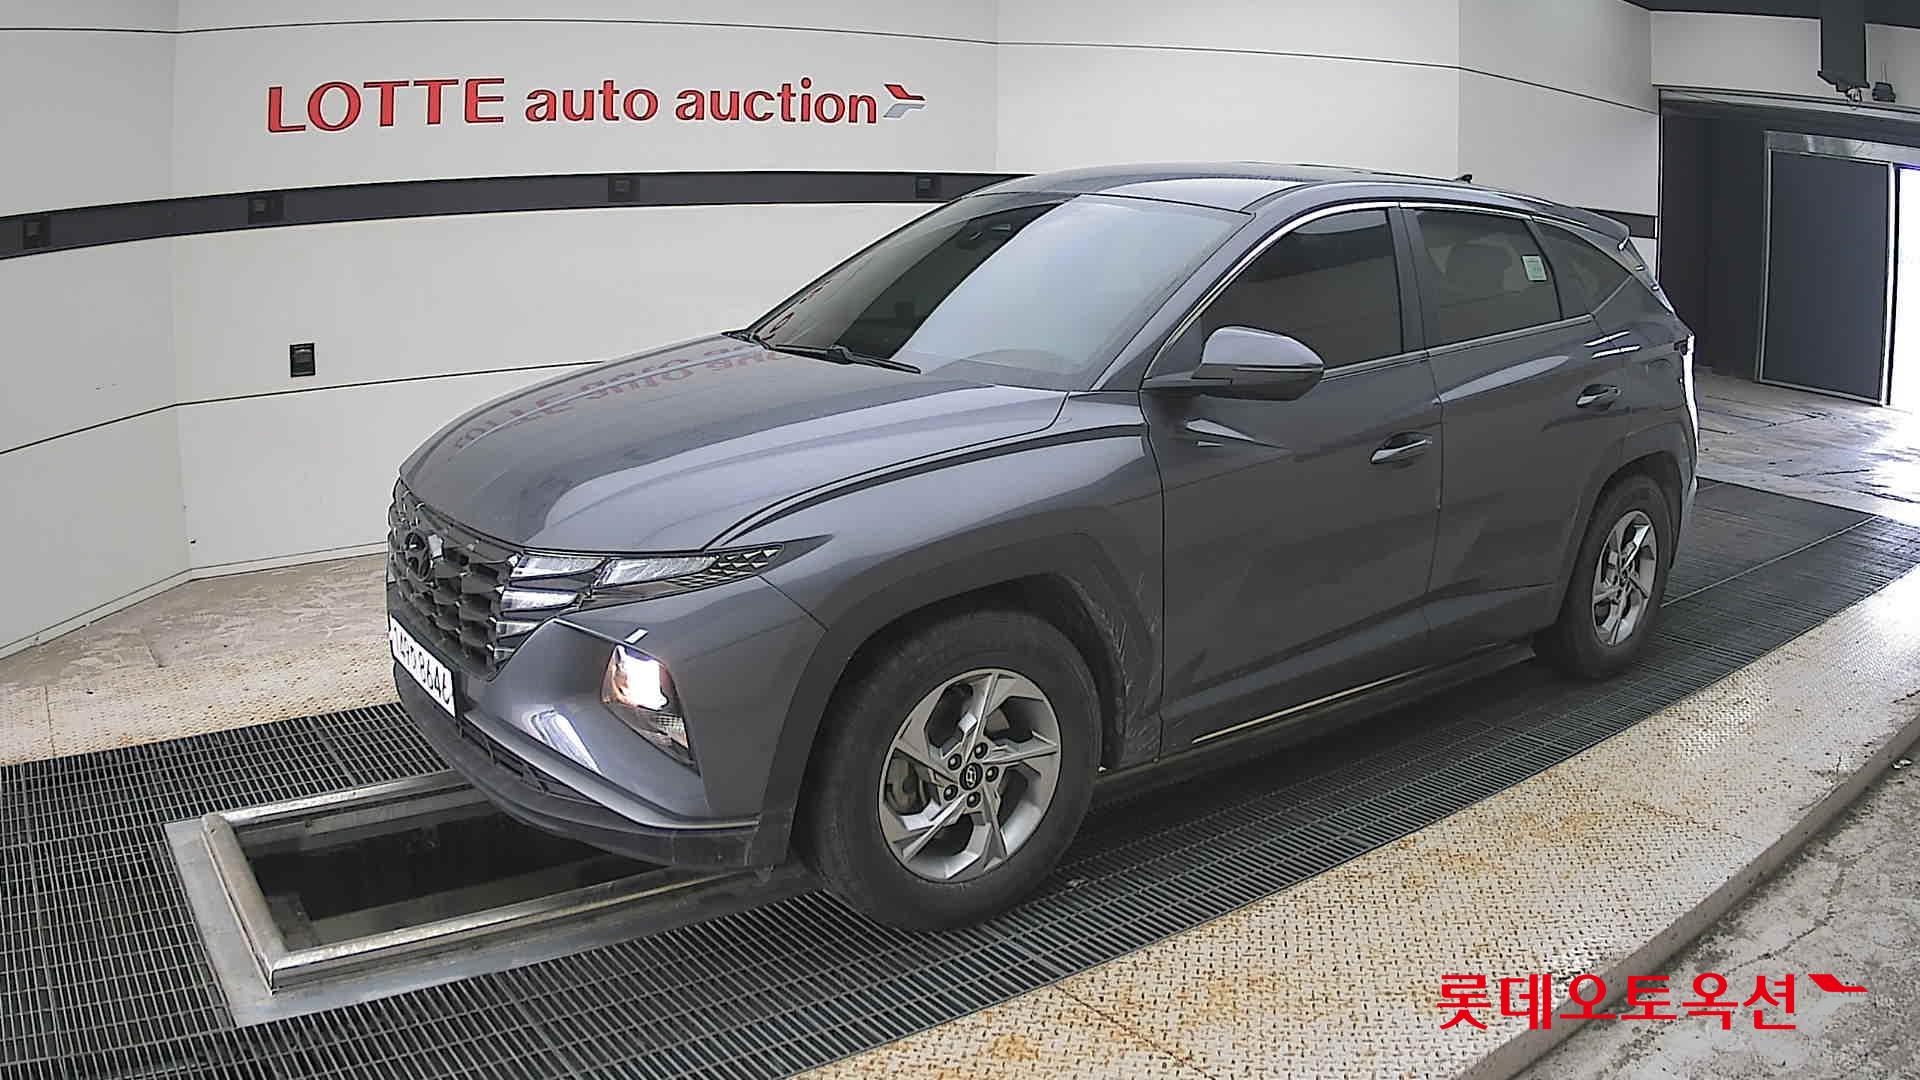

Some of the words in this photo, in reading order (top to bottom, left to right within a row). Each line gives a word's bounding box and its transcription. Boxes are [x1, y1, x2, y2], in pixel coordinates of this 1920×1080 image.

[267, 78, 505, 133] LOTTE
[525, 79, 659, 122] auto
[675, 77, 877, 124] auction
